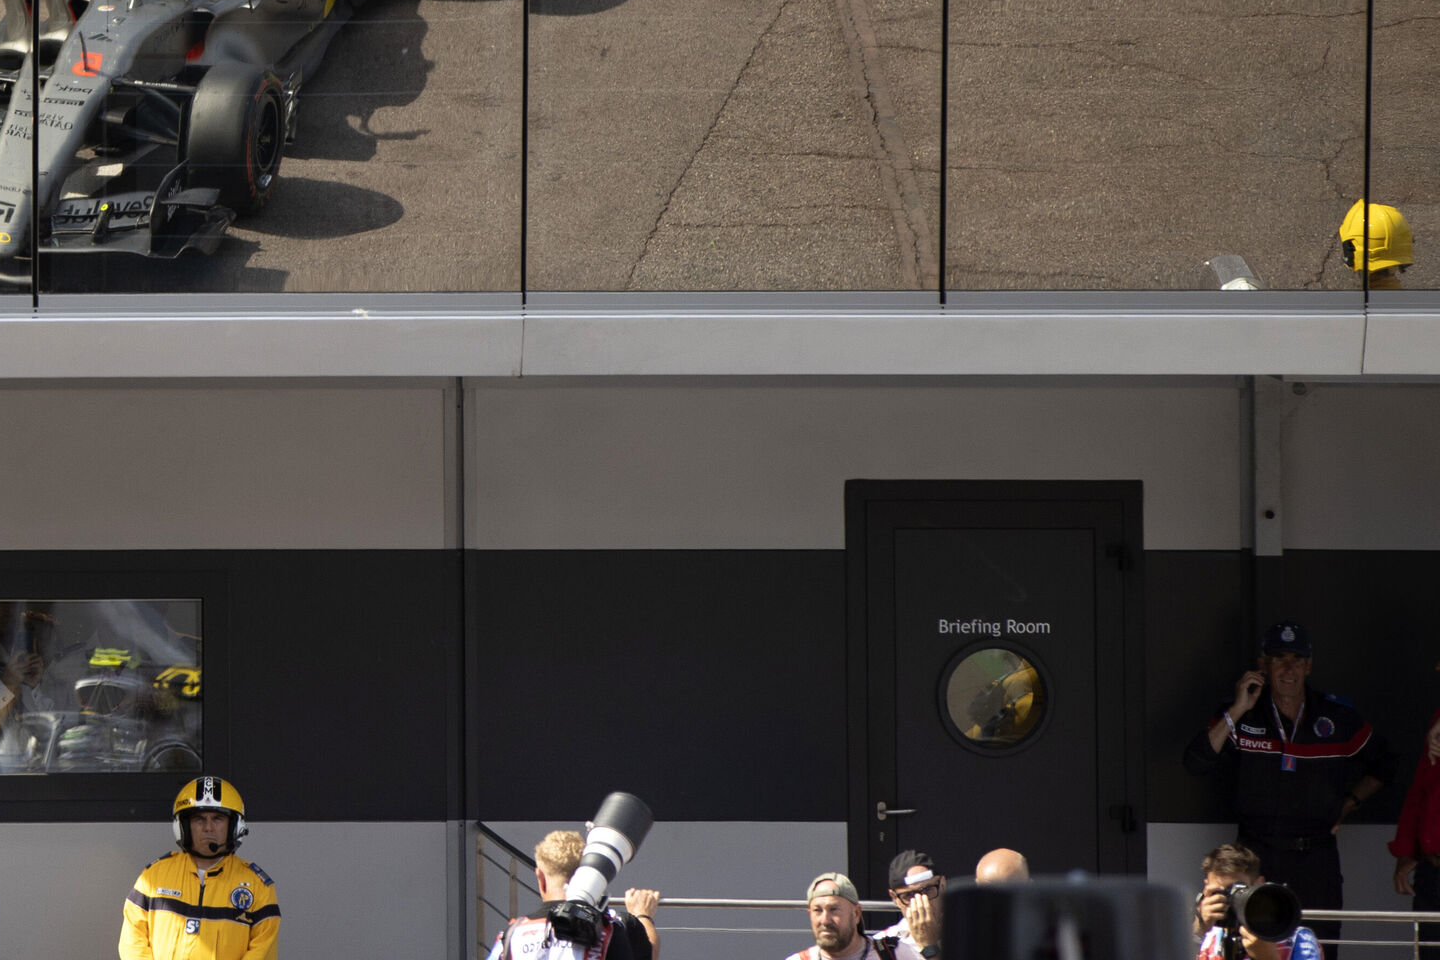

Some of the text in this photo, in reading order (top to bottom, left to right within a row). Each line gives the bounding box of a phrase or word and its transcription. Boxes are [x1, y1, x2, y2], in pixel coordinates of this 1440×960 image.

[938, 619, 1051, 637] Briefing Room
[1239, 738, 1272, 749] ERVICE
